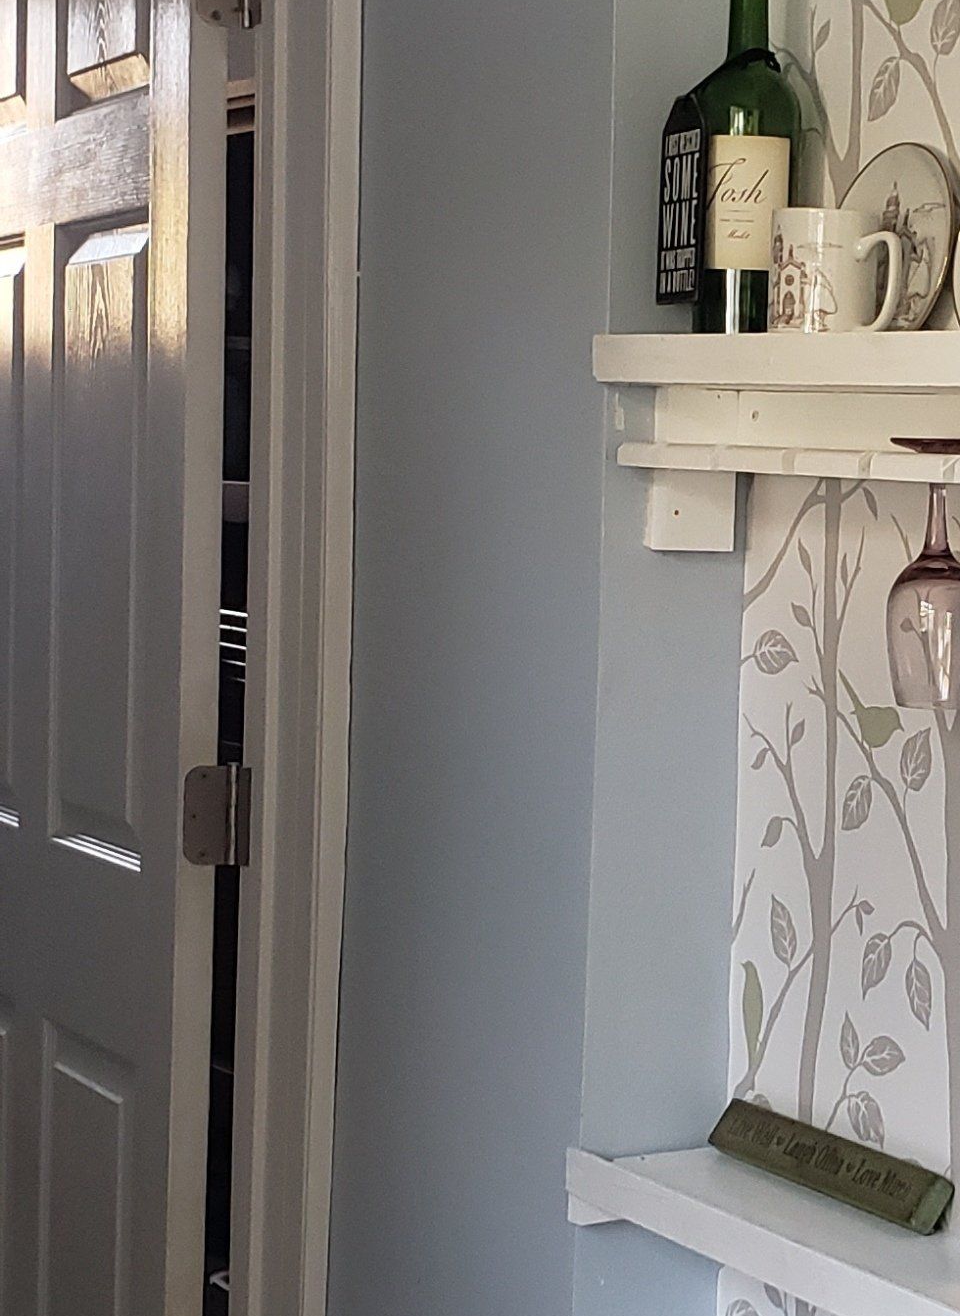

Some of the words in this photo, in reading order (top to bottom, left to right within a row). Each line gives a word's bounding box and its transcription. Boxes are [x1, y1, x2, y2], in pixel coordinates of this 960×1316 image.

[664, 153, 699, 202] SOME
[706, 157, 769, 210] Josh
[662, 200, 698, 249] WINE
